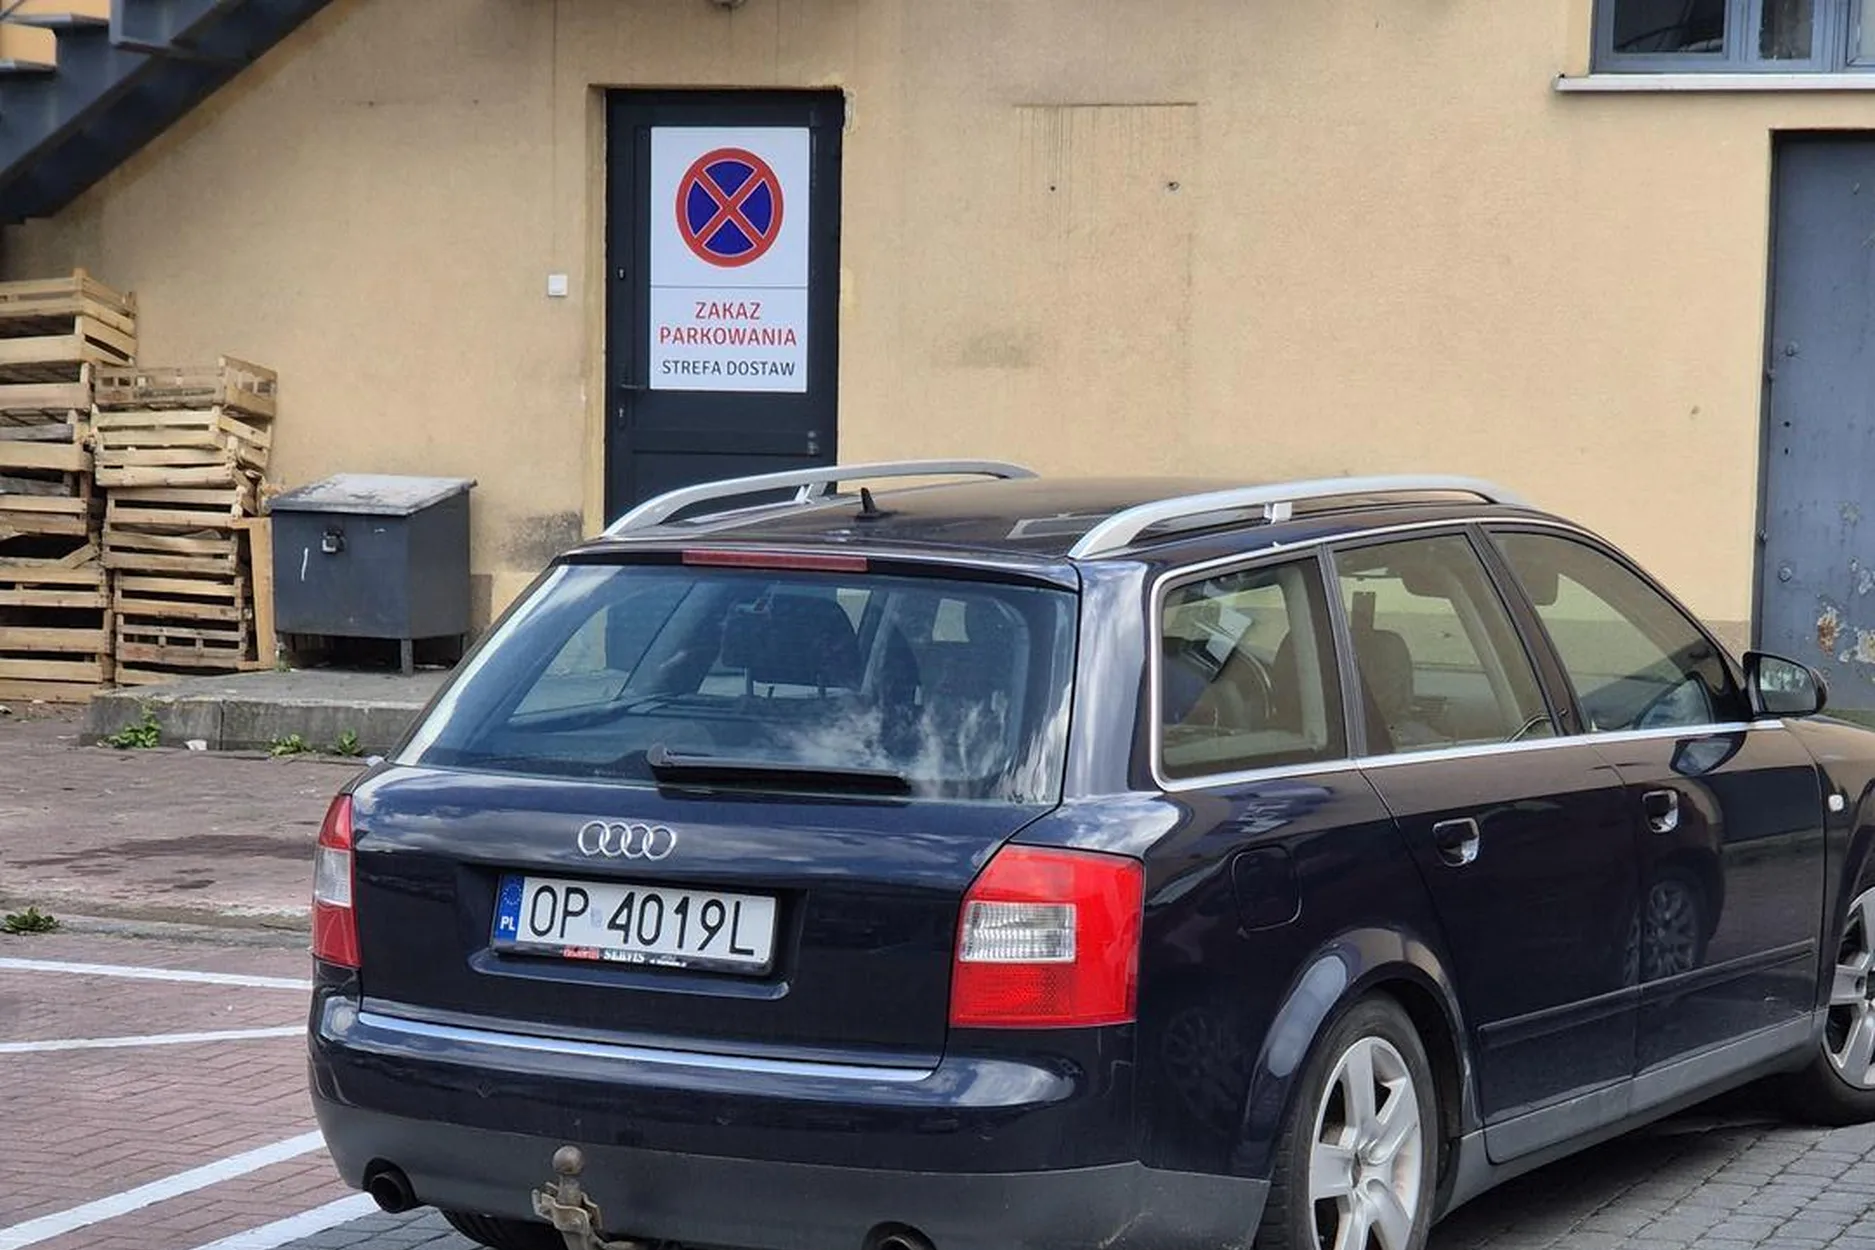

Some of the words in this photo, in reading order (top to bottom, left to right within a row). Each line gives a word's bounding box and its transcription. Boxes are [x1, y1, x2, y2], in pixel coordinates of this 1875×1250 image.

[695, 301, 761, 320] ZAKAZ
[659, 327, 797, 346] PARKOWANIA
[662, 360, 722, 375] STREFA
[726, 360, 795, 376] DOSTAW
[500, 916, 516, 931] PL
[529, 885, 589, 939] OP
[607, 891, 754, 956] 4019L
